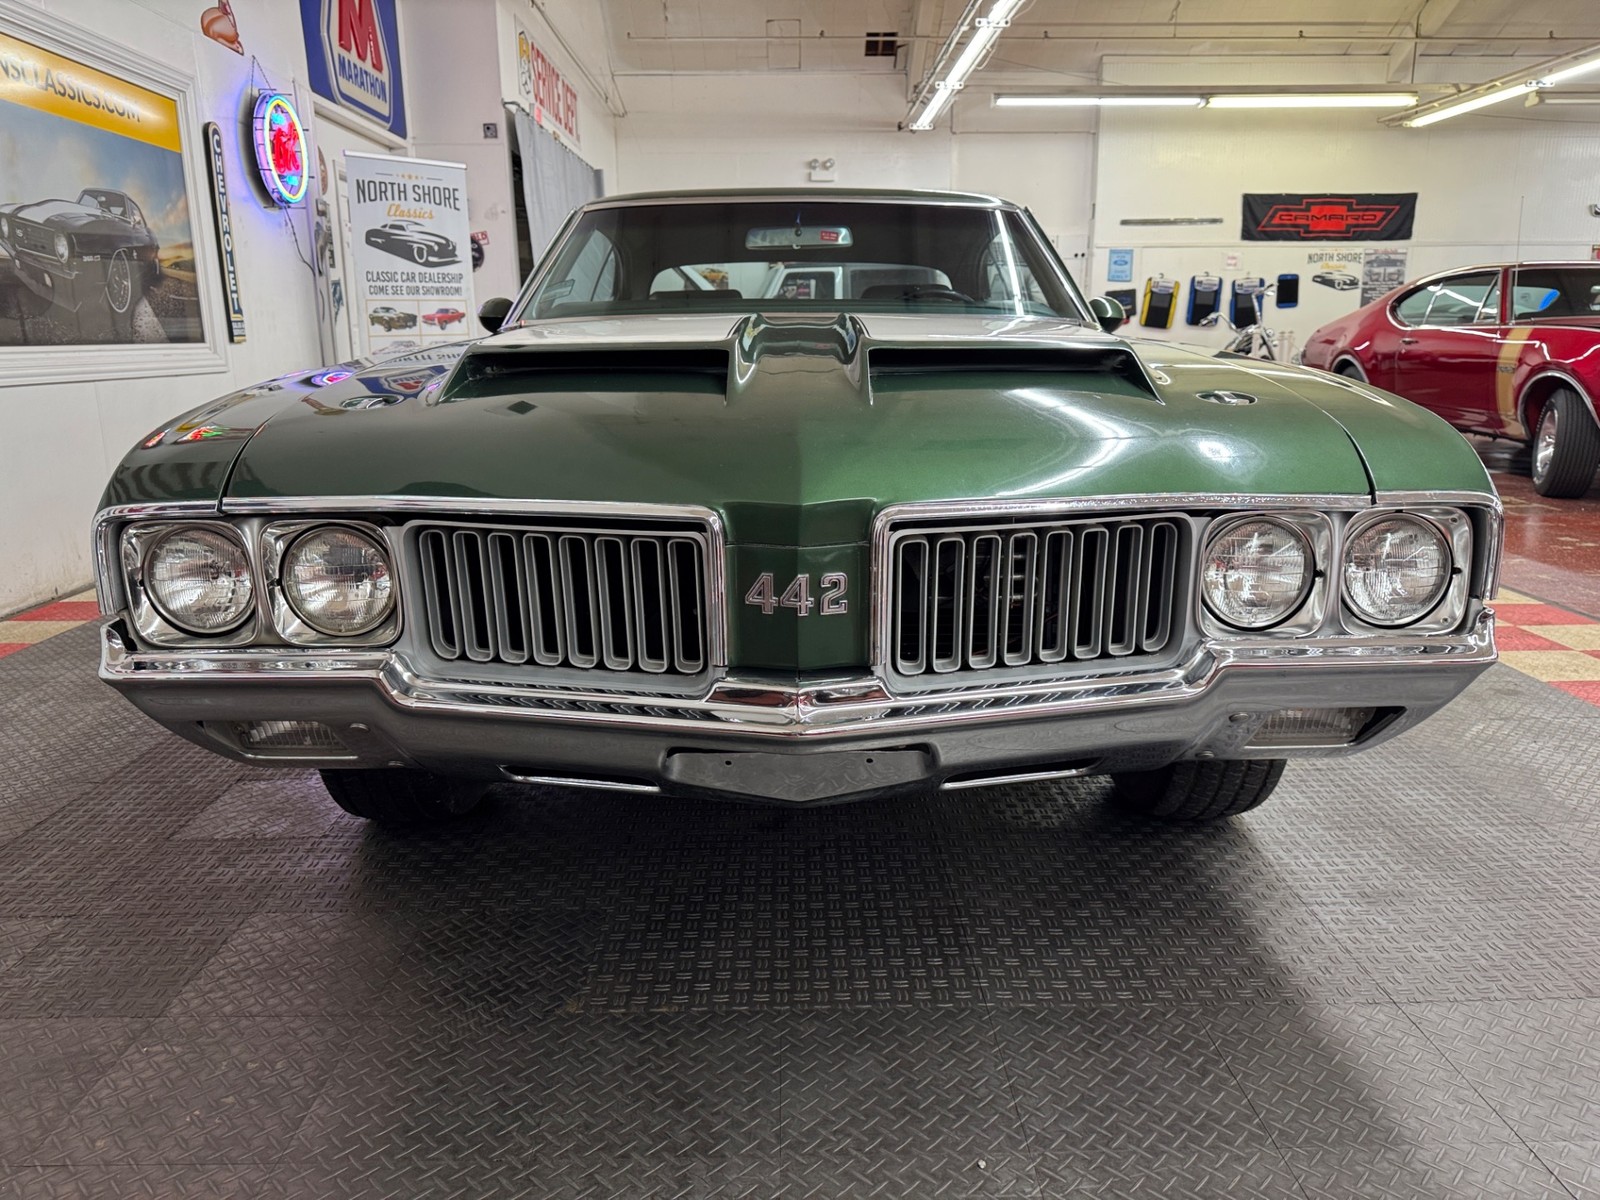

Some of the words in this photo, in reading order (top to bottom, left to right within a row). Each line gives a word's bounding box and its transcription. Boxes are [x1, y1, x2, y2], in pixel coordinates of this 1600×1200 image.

[338, 53, 388, 104] MARATHON
[356, 179, 408, 204] NORTH
[412, 184, 460, 211] SHORE
[387, 203, 434, 219] Classics
[1279, 214, 1377, 222] CAMARO
[213, 133, 240, 311] CHEVROLET
[1307, 252, 1334, 264] NORTH
[1336, 252, 1362, 264] SHORE
[365, 271, 399, 283] CLASSIC
[400, 272, 416, 283] CAR
[419, 272, 463, 284] DEALERSHIP
[369, 285, 390, 296] COME
[391, 285, 404, 296] SEE
[406, 286, 420, 296] OUR
[422, 286, 462, 296] SHOWROOM!
[745, 572, 848, 616] 442
